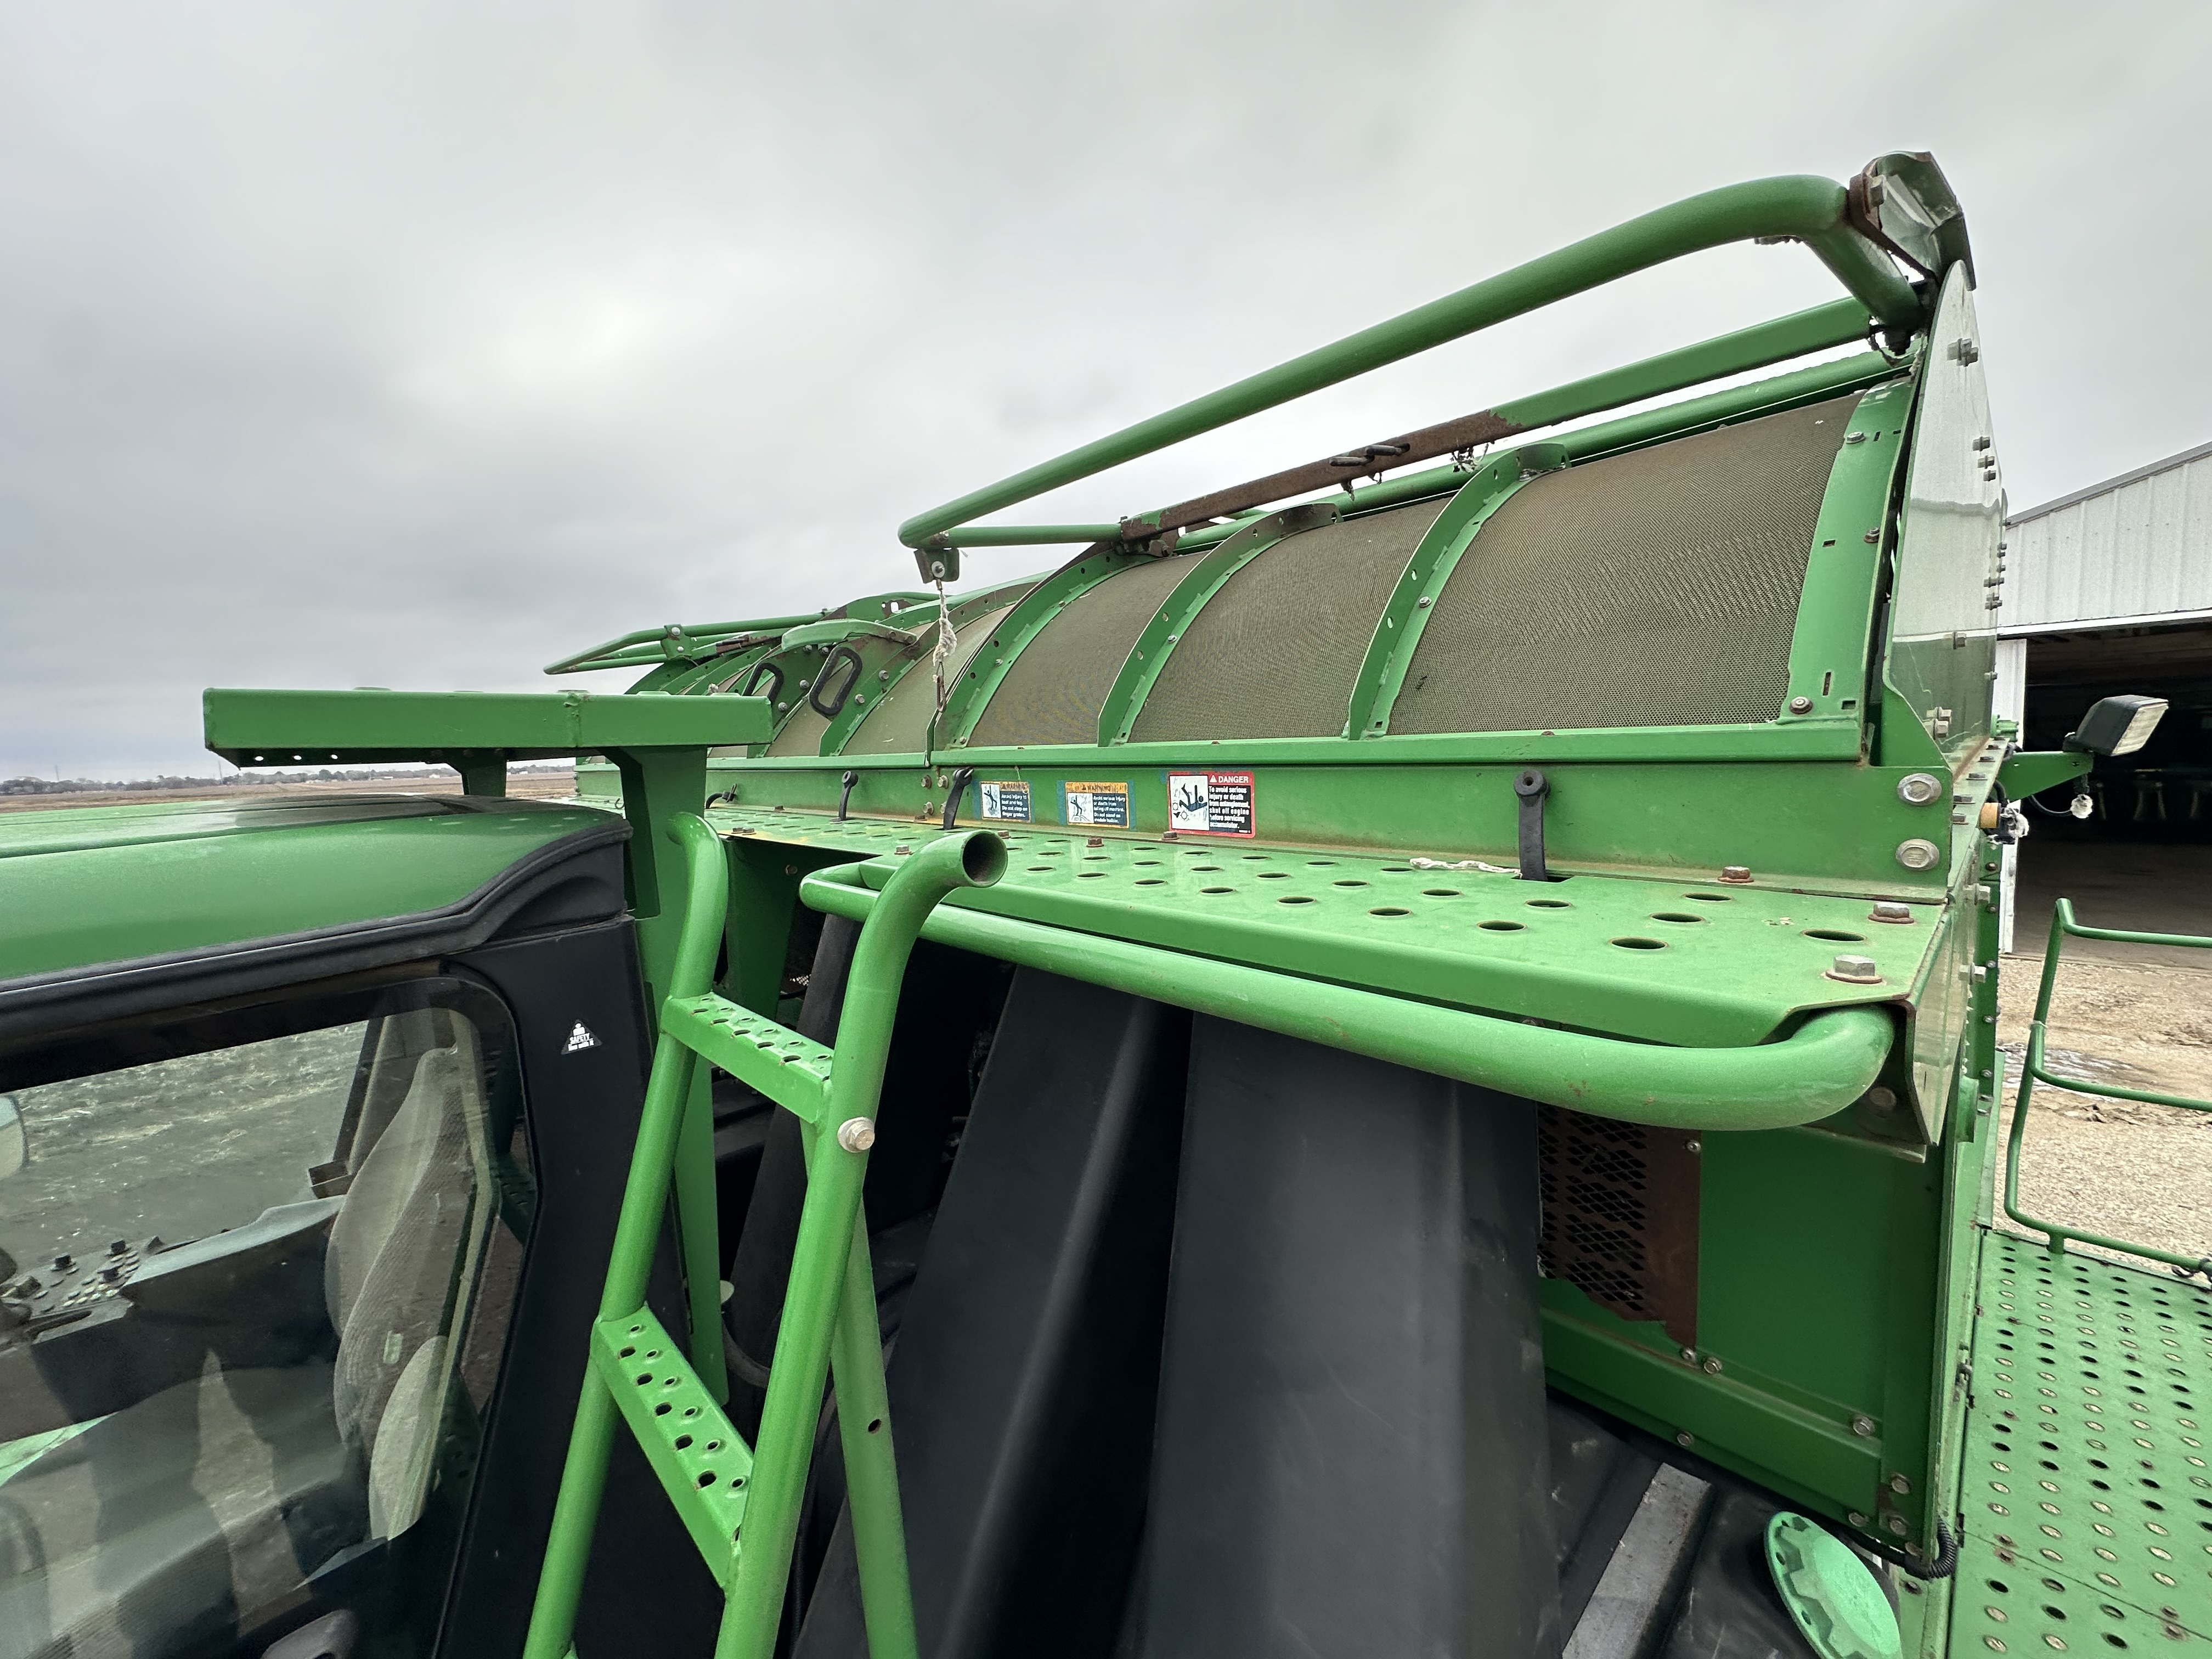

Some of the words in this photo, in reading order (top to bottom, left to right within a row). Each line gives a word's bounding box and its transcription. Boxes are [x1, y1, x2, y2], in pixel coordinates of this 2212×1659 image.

[1209, 793, 1223, 801] injury
[1230, 808, 1249, 816] engine
[1224, 815, 1245, 823] servicing
[569, 1033, 590, 1045] SAFETY
